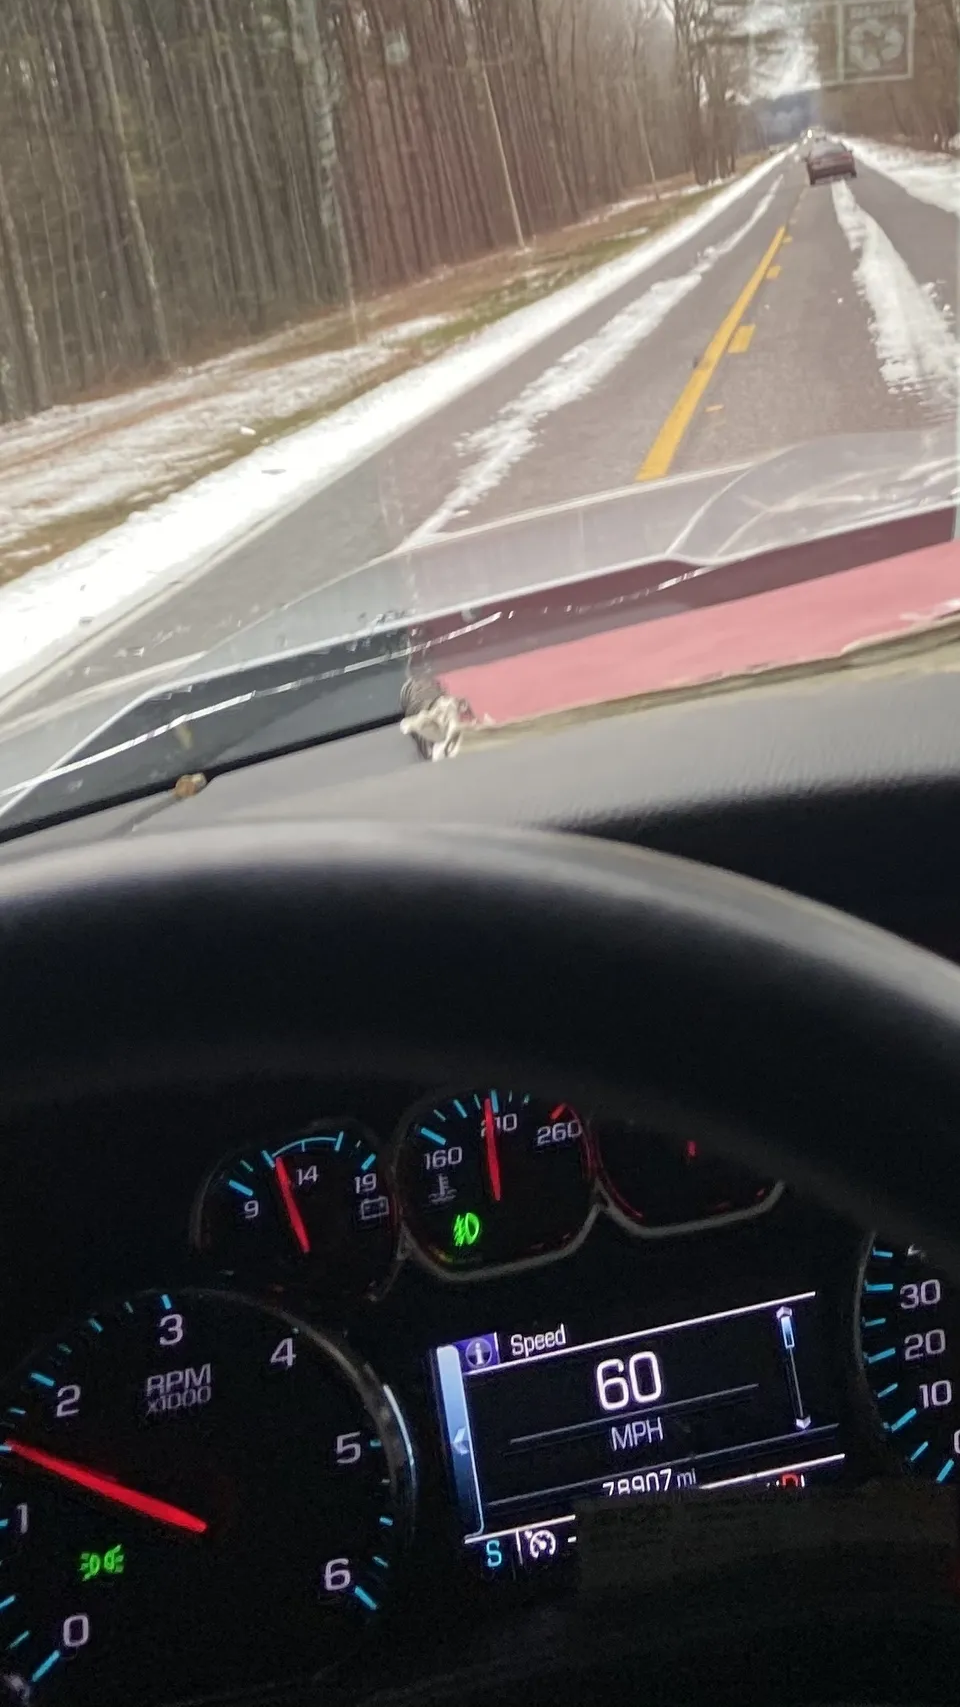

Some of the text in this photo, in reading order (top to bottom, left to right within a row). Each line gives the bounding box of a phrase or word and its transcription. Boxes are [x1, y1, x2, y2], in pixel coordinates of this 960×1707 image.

[537, 1120, 582, 1146] 260
[424, 1146, 463, 1170] 160
[296, 1165, 319, 1185] 14
[354, 1173, 377, 1194] 19
[244, 1199, 260, 1219] 9
[900, 1279, 941, 1309] 30
[159, 1313, 184, 1346] 3
[510, 1323, 566, 1357] Speed
[904, 1329, 946, 1361] 20
[270, 1337, 297, 1368] 4
[146, 1363, 211, 1397] RPM
[596, 1351, 662, 1411] 60
[919, 1380, 952, 1409] 10
[56, 1384, 81, 1418] 2
[335, 1431, 361, 1464] 5
[611, 1416, 664, 1451] MPH
[602, 1468, 697, 1496] 78907 mi
[16, 1502, 28, 1534] 1
[485, 1539, 502, 1568] S
[323, 1557, 351, 1592] 6
[62, 1613, 90, 1647] 0
